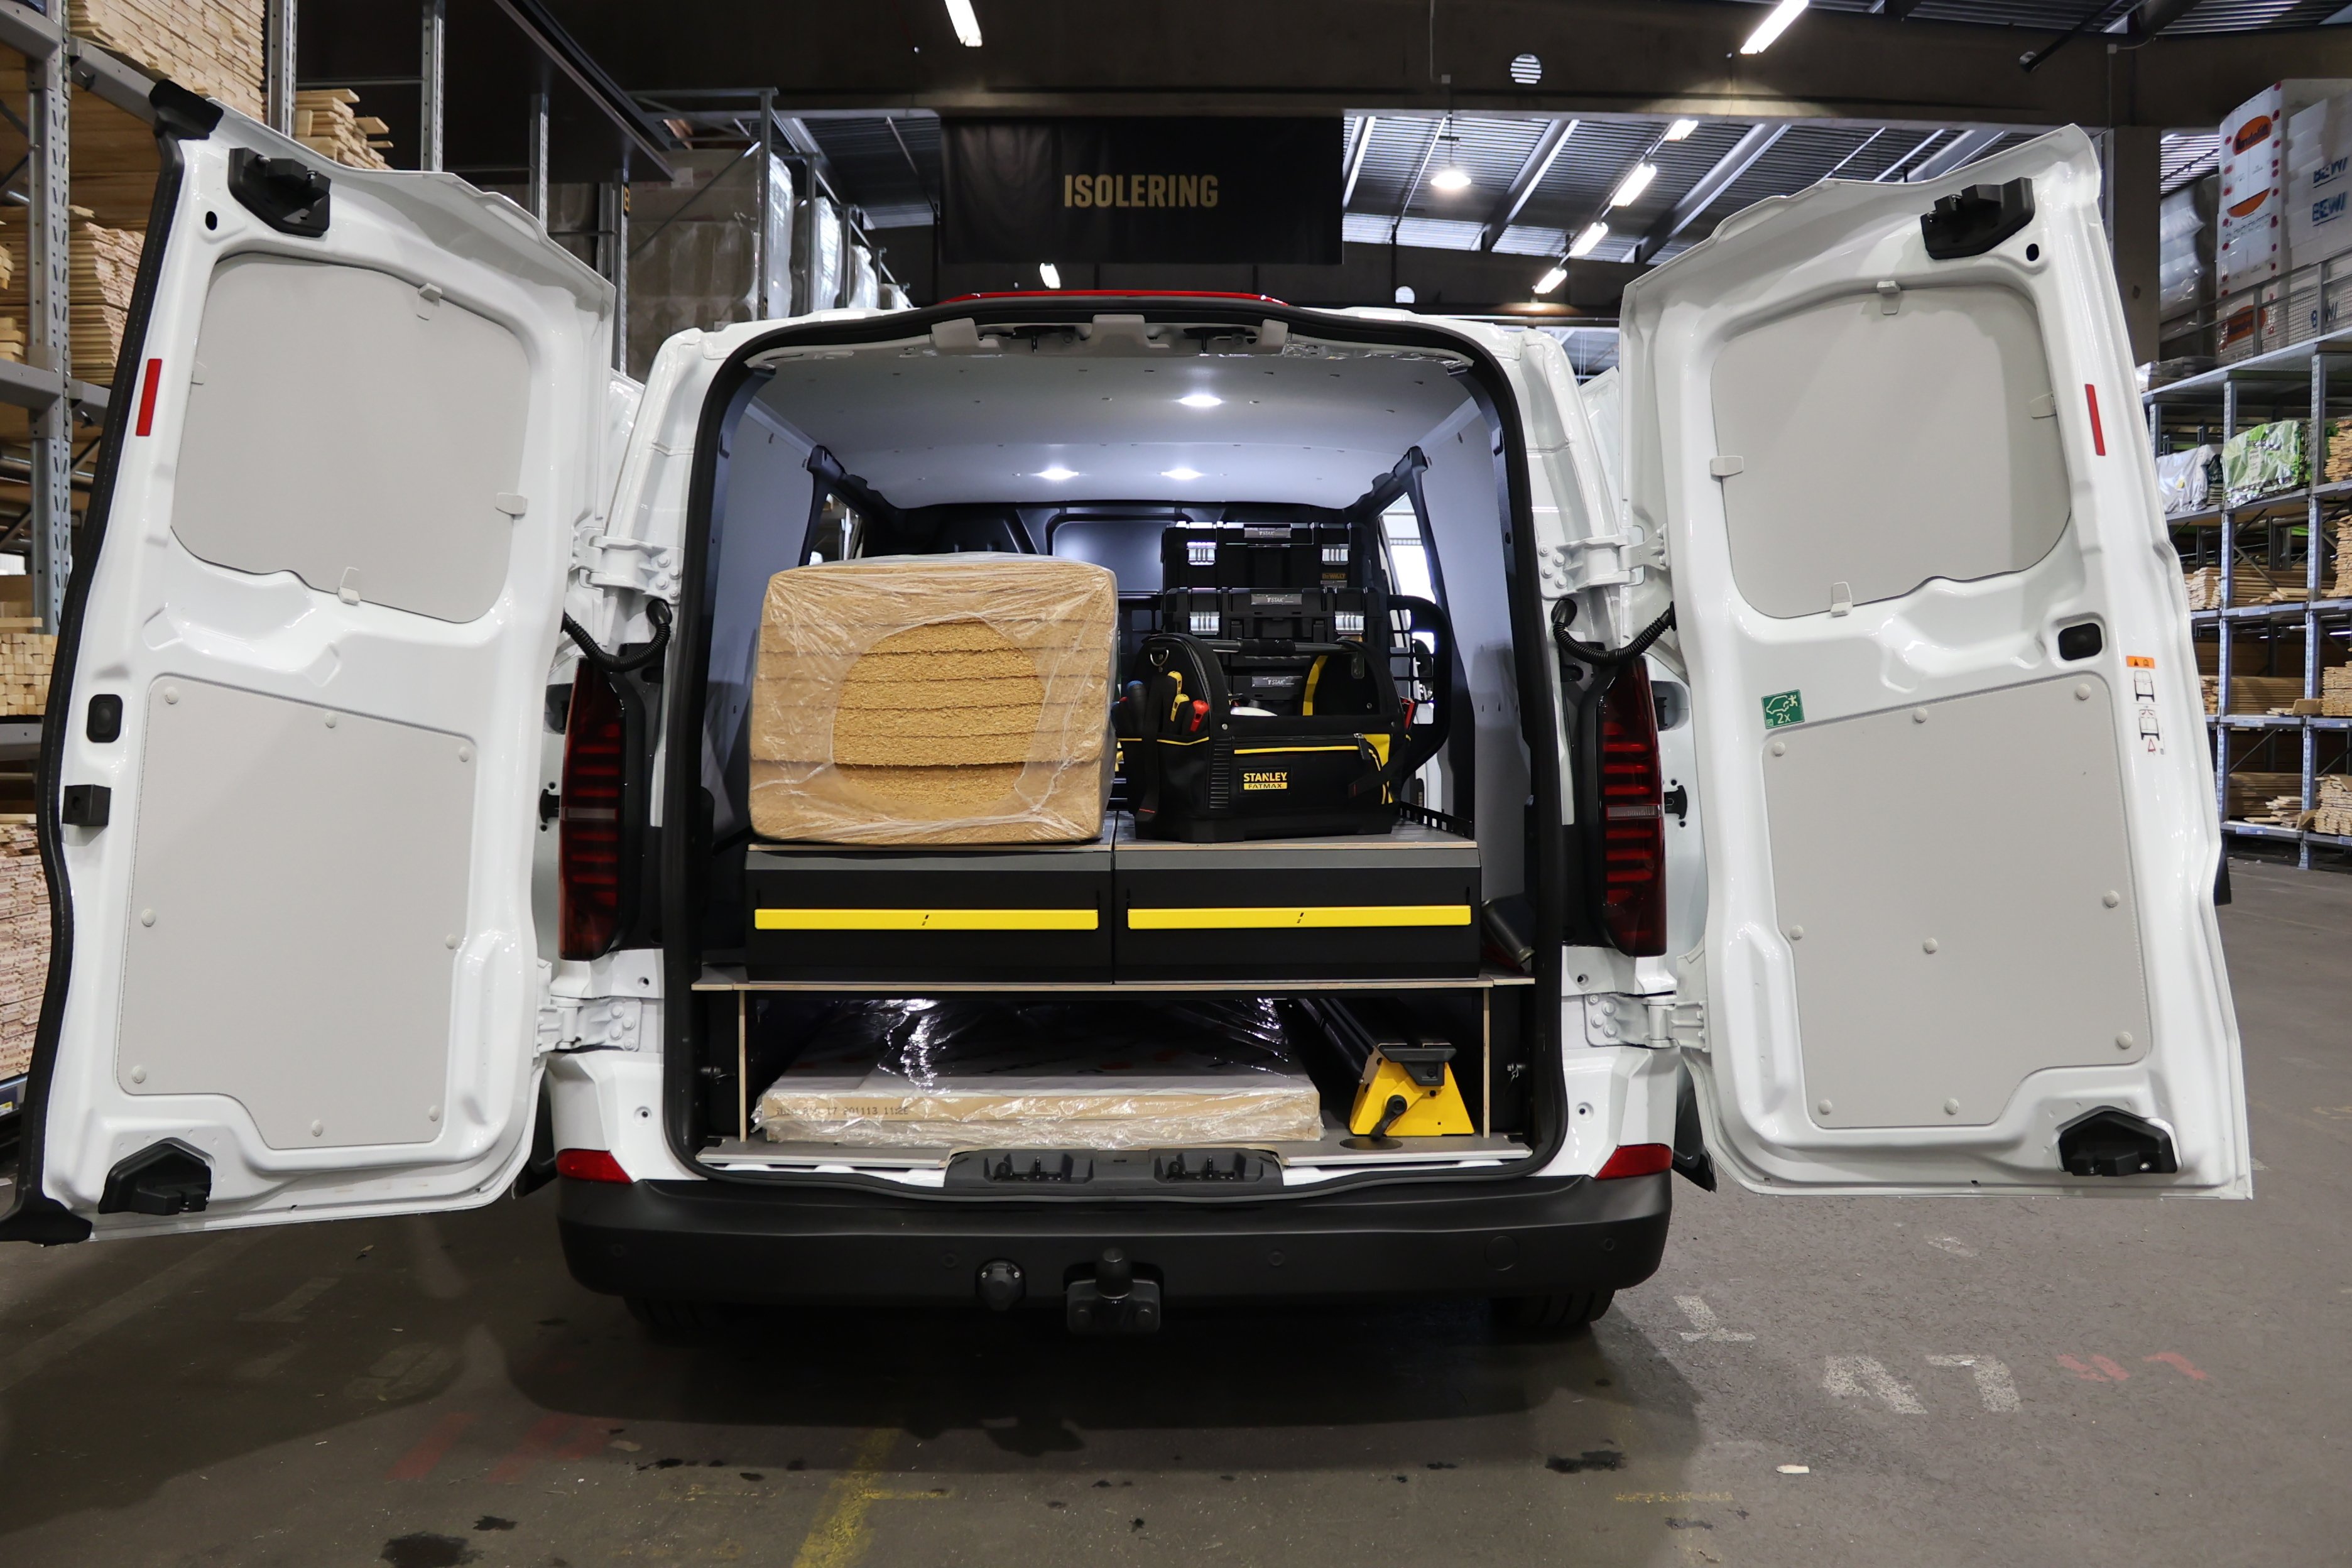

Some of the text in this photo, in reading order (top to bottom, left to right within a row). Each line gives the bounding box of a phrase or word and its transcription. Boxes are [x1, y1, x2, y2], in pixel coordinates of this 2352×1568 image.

[1064, 174, 1218, 208] ISOLERING
[2312, 191, 2348, 222] BEWI
[1243, 772, 1287, 781] STANLEY
